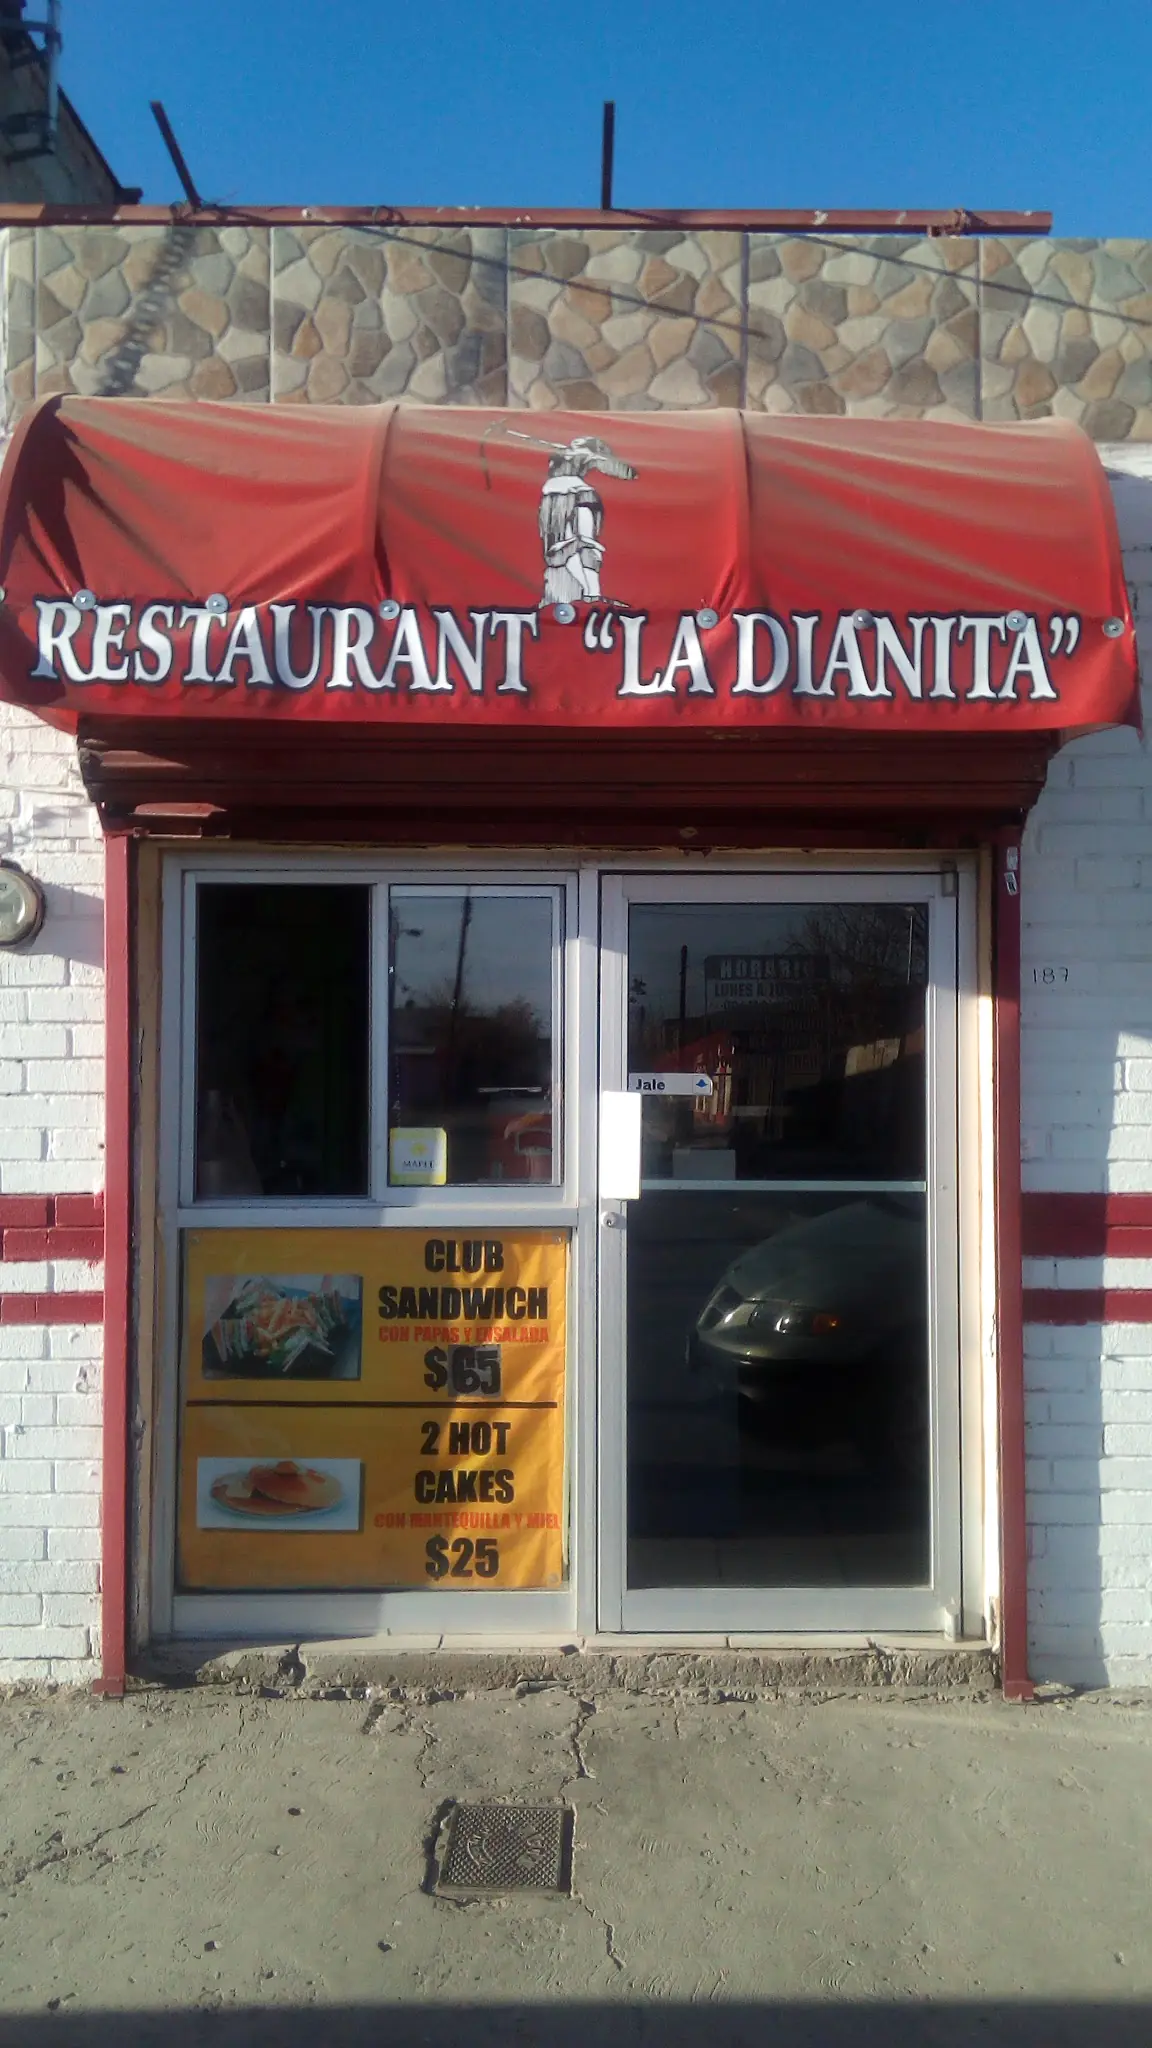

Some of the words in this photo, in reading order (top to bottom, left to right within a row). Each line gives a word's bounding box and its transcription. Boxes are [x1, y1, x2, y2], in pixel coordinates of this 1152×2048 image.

[30, 599, 538, 692] RESTAURANT
[1033, 967, 1069, 984] 187
[635, 1078, 666, 1091] Jale
[424, 1239, 504, 1273] CLUB
[378, 1285, 549, 1320] SANDWICH
[379, 1326, 409, 1343] CON
[414, 1326, 460, 1343] PAPAS
[463, 1327, 472, 1343] Y
[476, 1326, 549, 1344] ENSALADA
[423, 1346, 502, 1394] $65
[420, 1421, 440, 1455] 2
[448, 1421, 511, 1456] HOT
[414, 1469, 515, 1504] CAKES
[373, 1513, 405, 1530] CON
[410, 1512, 510, 1530] MANTEQUILLA
[514, 1512, 523, 1530] Y
[527, 1512, 561, 1530] MIEL
[425, 1534, 499, 1581] $25
